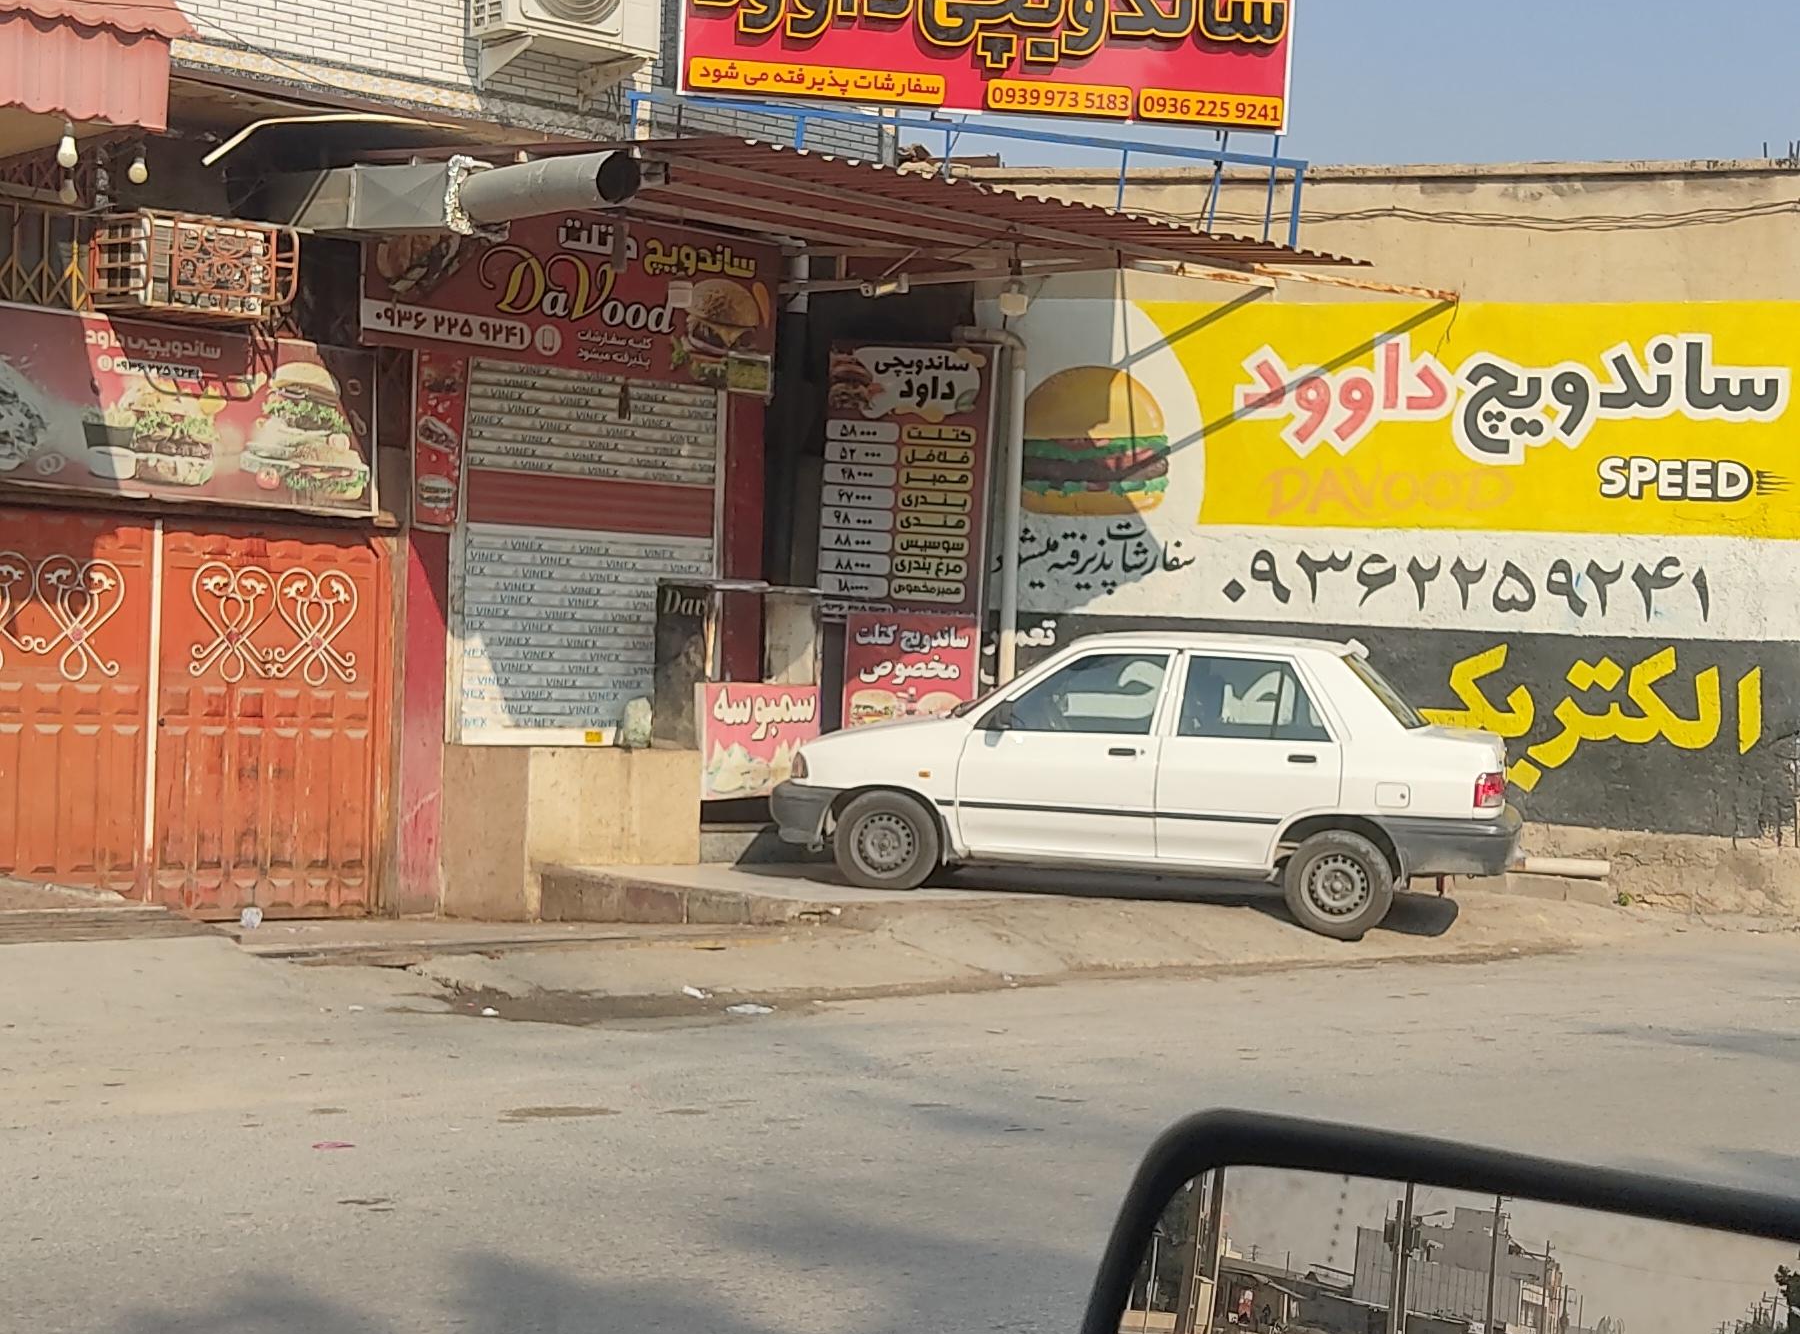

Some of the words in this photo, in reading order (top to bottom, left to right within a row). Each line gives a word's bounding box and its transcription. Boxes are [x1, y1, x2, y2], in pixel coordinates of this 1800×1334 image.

[700, 63, 739, 83] شود
[774, 68, 849, 95] پذیرفته
[854, 74, 940, 97] سفارشات
[992, 87, 1040, 105] 0939
[1044, 90, 1079, 107] 973
[1084, 93, 1129, 111] 5183
[1144, 96, 1191, 115] 0936
[1196, 99, 1230, 118] 225
[1235, 103, 1280, 122] 9241
[644, 239, 756, 278] ساندویچ
[479, 244, 675, 334] DaVood
[375, 307, 427, 330] ۰۹۳۶
[434, 315, 473, 337] ۲۲۵
[479, 321, 524, 345] ۹۲۴۱
[127, 337, 221, 359] ساندویچی
[874, 355, 969, 377] ساندویچی
[899, 376, 955, 408] داود
[1242, 341, 1448, 444] داوود
[1463, 340, 1779, 454] ساندویچ
[907, 426, 971, 442] کتلت
[905, 449, 970, 464] فلافل
[904, 471, 968, 486] همبر
[1258, 460, 1516, 520] DAVOOD
[1598, 456, 1753, 503] SPEED
[901, 493, 967, 511] بندری
[900, 538, 964, 553] سوسیس
[1107, 521, 1196, 576] سفارشات
[894, 556, 931, 574] بندری
[935, 558, 962, 577] مرغ
[1222, 549, 1710, 624] ۰۹۳۶۲۲۵۹۲۴۱
[855, 622, 899, 646] کتلت
[900, 626, 969, 654] ساندویچ
[859, 654, 960, 685] مخصوص
[712, 686, 817, 740] سمبوسه
